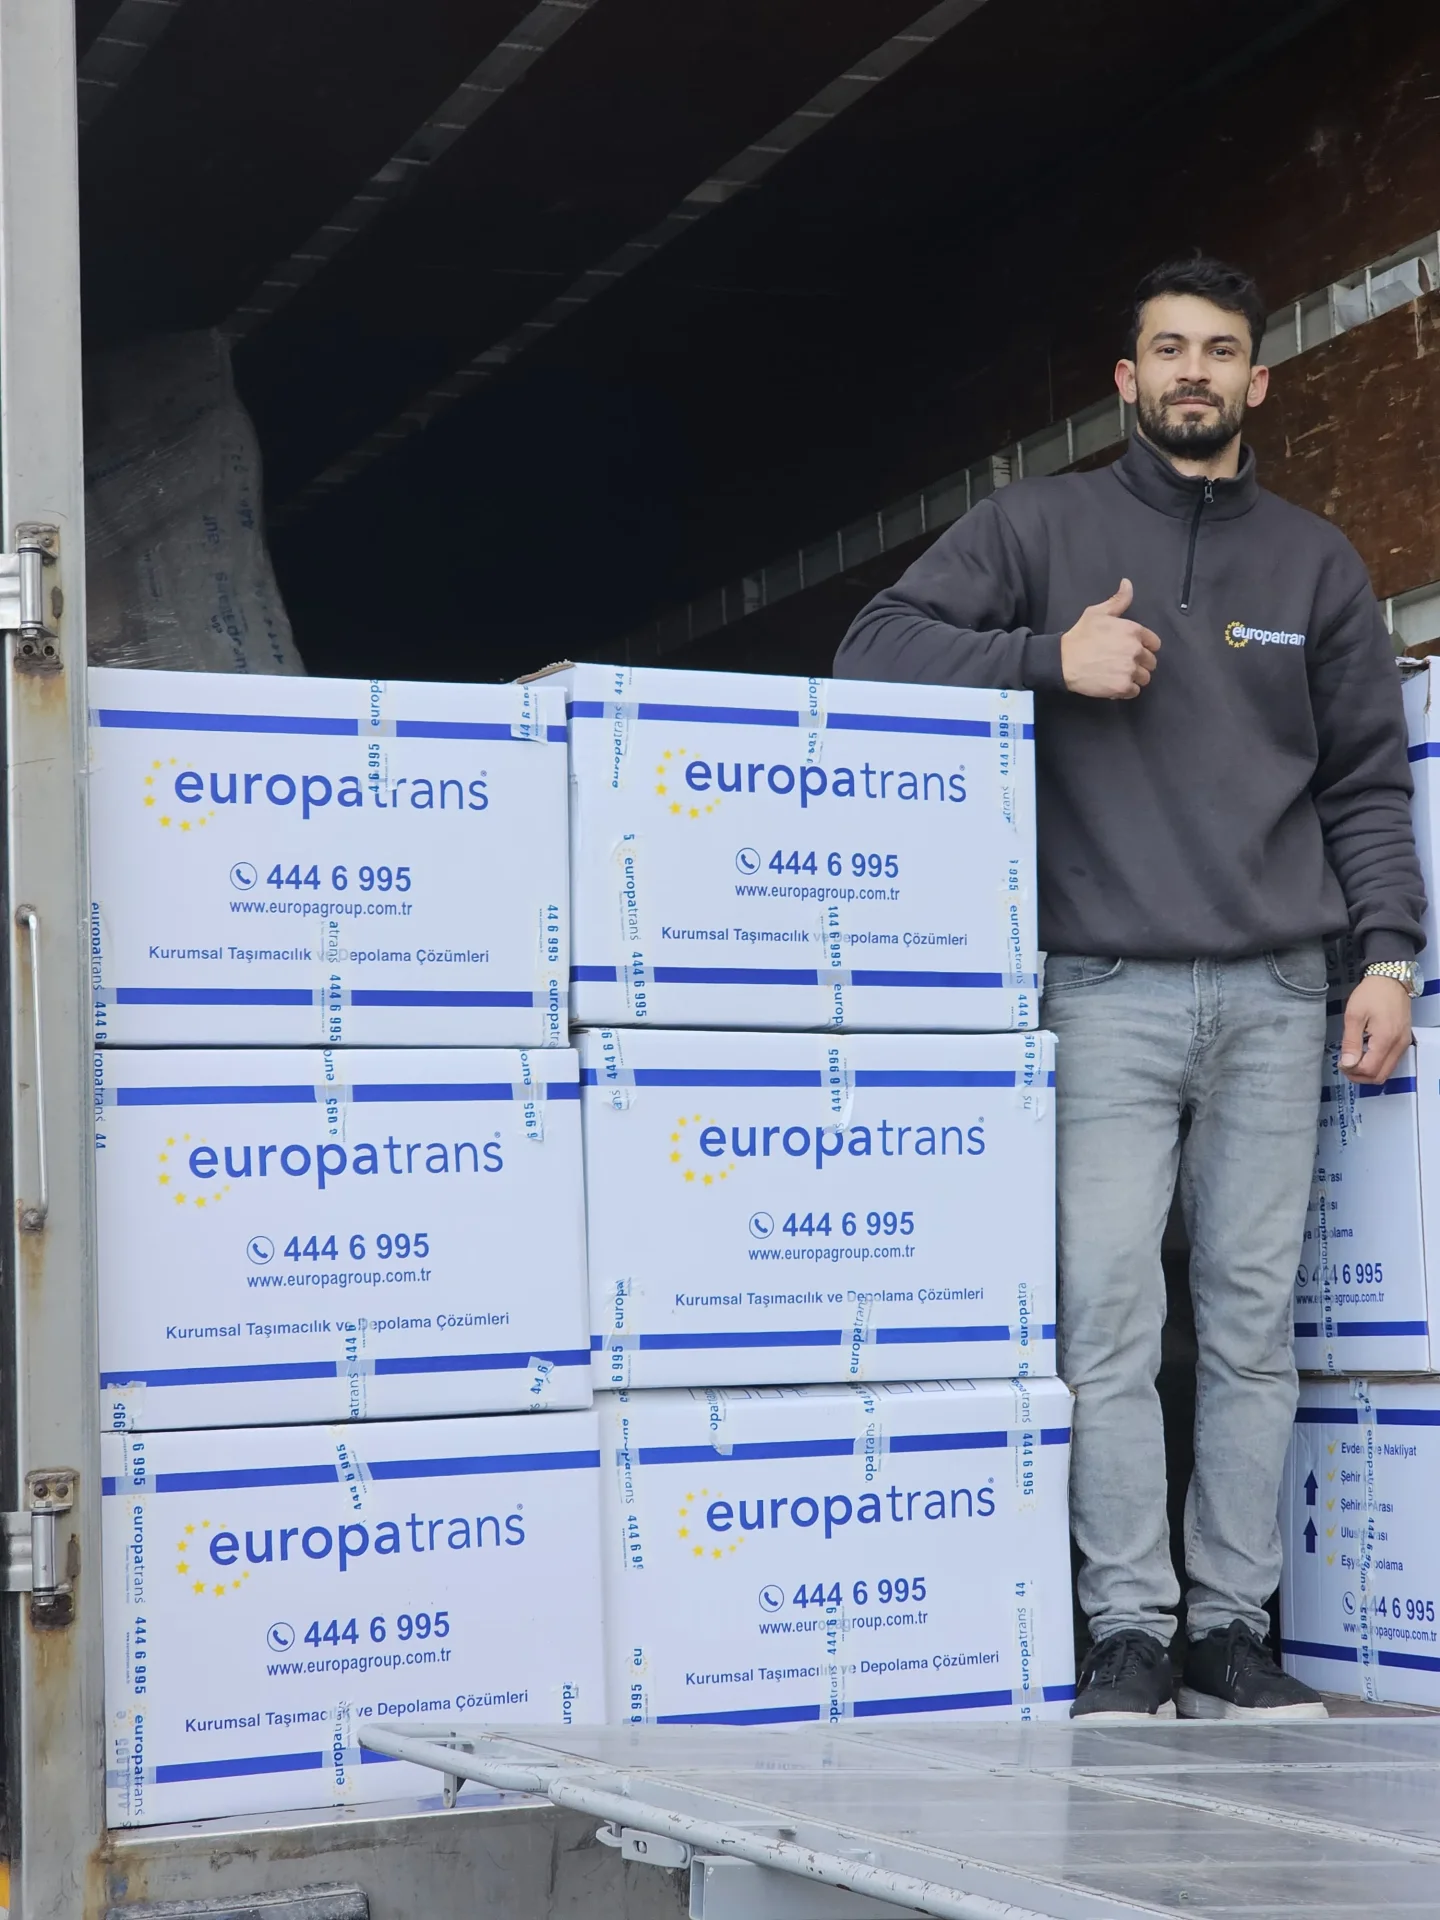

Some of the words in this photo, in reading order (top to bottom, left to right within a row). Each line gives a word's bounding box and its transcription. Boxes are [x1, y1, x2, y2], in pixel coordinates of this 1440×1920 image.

[614, 673, 624, 695] 444
[1000, 714, 1009, 736] 995
[368, 744, 380, 768] 995
[1000, 754, 1009, 776] 444
[769, 850, 818, 875] 444
[828, 852, 842, 876] 6
[852, 853, 899, 878] 995
[267, 864, 321, 890] 444
[332, 865, 348, 891] 6
[359, 866, 411, 892] 995
[1009, 869, 1019, 891] 995
[624, 857, 640, 941] europatrans
[735, 885, 900, 902] www.europagroup.com.tr
[230, 902, 412, 918] www.europagroup.com.tr
[662, 927, 728, 940] Kurumsal
[733, 929, 809, 944] Taşımacılık
[903, 932, 967, 947] Çözümleri
[1010, 905, 1024, 985] europatrans
[150, 946, 222, 959] Kurumsal
[228, 947, 312, 963] Taşımacılık
[416, 949, 488, 965] Çözümleri
[548, 938, 559, 962] 995
[830, 944, 841, 968] 995
[632, 952, 644, 976] 444
[330, 974, 341, 998] 444
[634, 980, 645, 988] 6
[95, 1002, 106, 1026] 444
[634, 994, 647, 1017] 995
[1018, 994, 1029, 1016] 444
[330, 1017, 342, 1042] 995
[605, 1056, 618, 1080] 444
[828, 1049, 839, 1072] 995
[1024, 1064, 1035, 1086] 444
[831, 1089, 842, 1112] 444
[524, 1102, 537, 1128] 995
[782, 1212, 832, 1237] 444
[842, 1212, 856, 1236] 6
[867, 1212, 914, 1236] 995
[284, 1235, 338, 1261] 444
[349, 1234, 365, 1260] 6
[376, 1233, 429, 1259] 995
[749, 1245, 915, 1262] www.europagroup.com.tr
[247, 1268, 431, 1288] www.europagroup.com.tr
[1343, 1264, 1351, 1284] 6
[1356, 1262, 1383, 1284] 995
[676, 1293, 742, 1306] Kurumsal
[747, 1292, 822, 1307] Taşımacılık
[827, 1294, 843, 1302] ve
[918, 1288, 983, 1304] Çözümleri
[167, 1324, 240, 1339] Kurumsal
[246, 1320, 331, 1338] Taşımacılık
[437, 1312, 509, 1330] Çözümleri
[345, 1337, 357, 1362] 444
[612, 1345, 624, 1369] 995
[113, 1402, 126, 1428] 995
[1022, 1433, 1033, 1456] 444
[1384, 1444, 1416, 1459] Nakliyat
[133, 1458, 146, 1485] 995
[1023, 1472, 1034, 1495] 995
[627, 1515, 639, 1539] 444
[130, 1506, 146, 1604] europatrans
[793, 1582, 843, 1611] 444
[853, 1581, 868, 1605] 6
[878, 1577, 926, 1603] 995
[1392, 1598, 1401, 1618] 6
[1406, 1599, 1434, 1622] 995
[135, 1616, 147, 1644] 444
[304, 1618, 359, 1647] 444
[370, 1616, 386, 1643] 6
[397, 1611, 449, 1640] 995
[135, 1651, 146, 1659] 6
[827, 1632, 836, 1655] 444
[1018, 1608, 1031, 1690] europatrans
[267, 1646, 451, 1676] www.europagroup.com.tr
[633, 1648, 642, 1666] eu
[686, 1669, 753, 1685] Kurumsal
[861, 1658, 928, 1675] Depolama
[933, 1651, 999, 1671] Çözümleri
[135, 1666, 147, 1694] 995
[631, 1684, 642, 1710] 995
[186, 1713, 260, 1732] Kurumsal
[356, 1704, 373, 1718] ve
[378, 1698, 450, 1717] Depolama
[456, 1690, 527, 1712] Çözümleri
[631, 1715, 642, 1723] 6
[131, 1714, 145, 1816] europatrans
